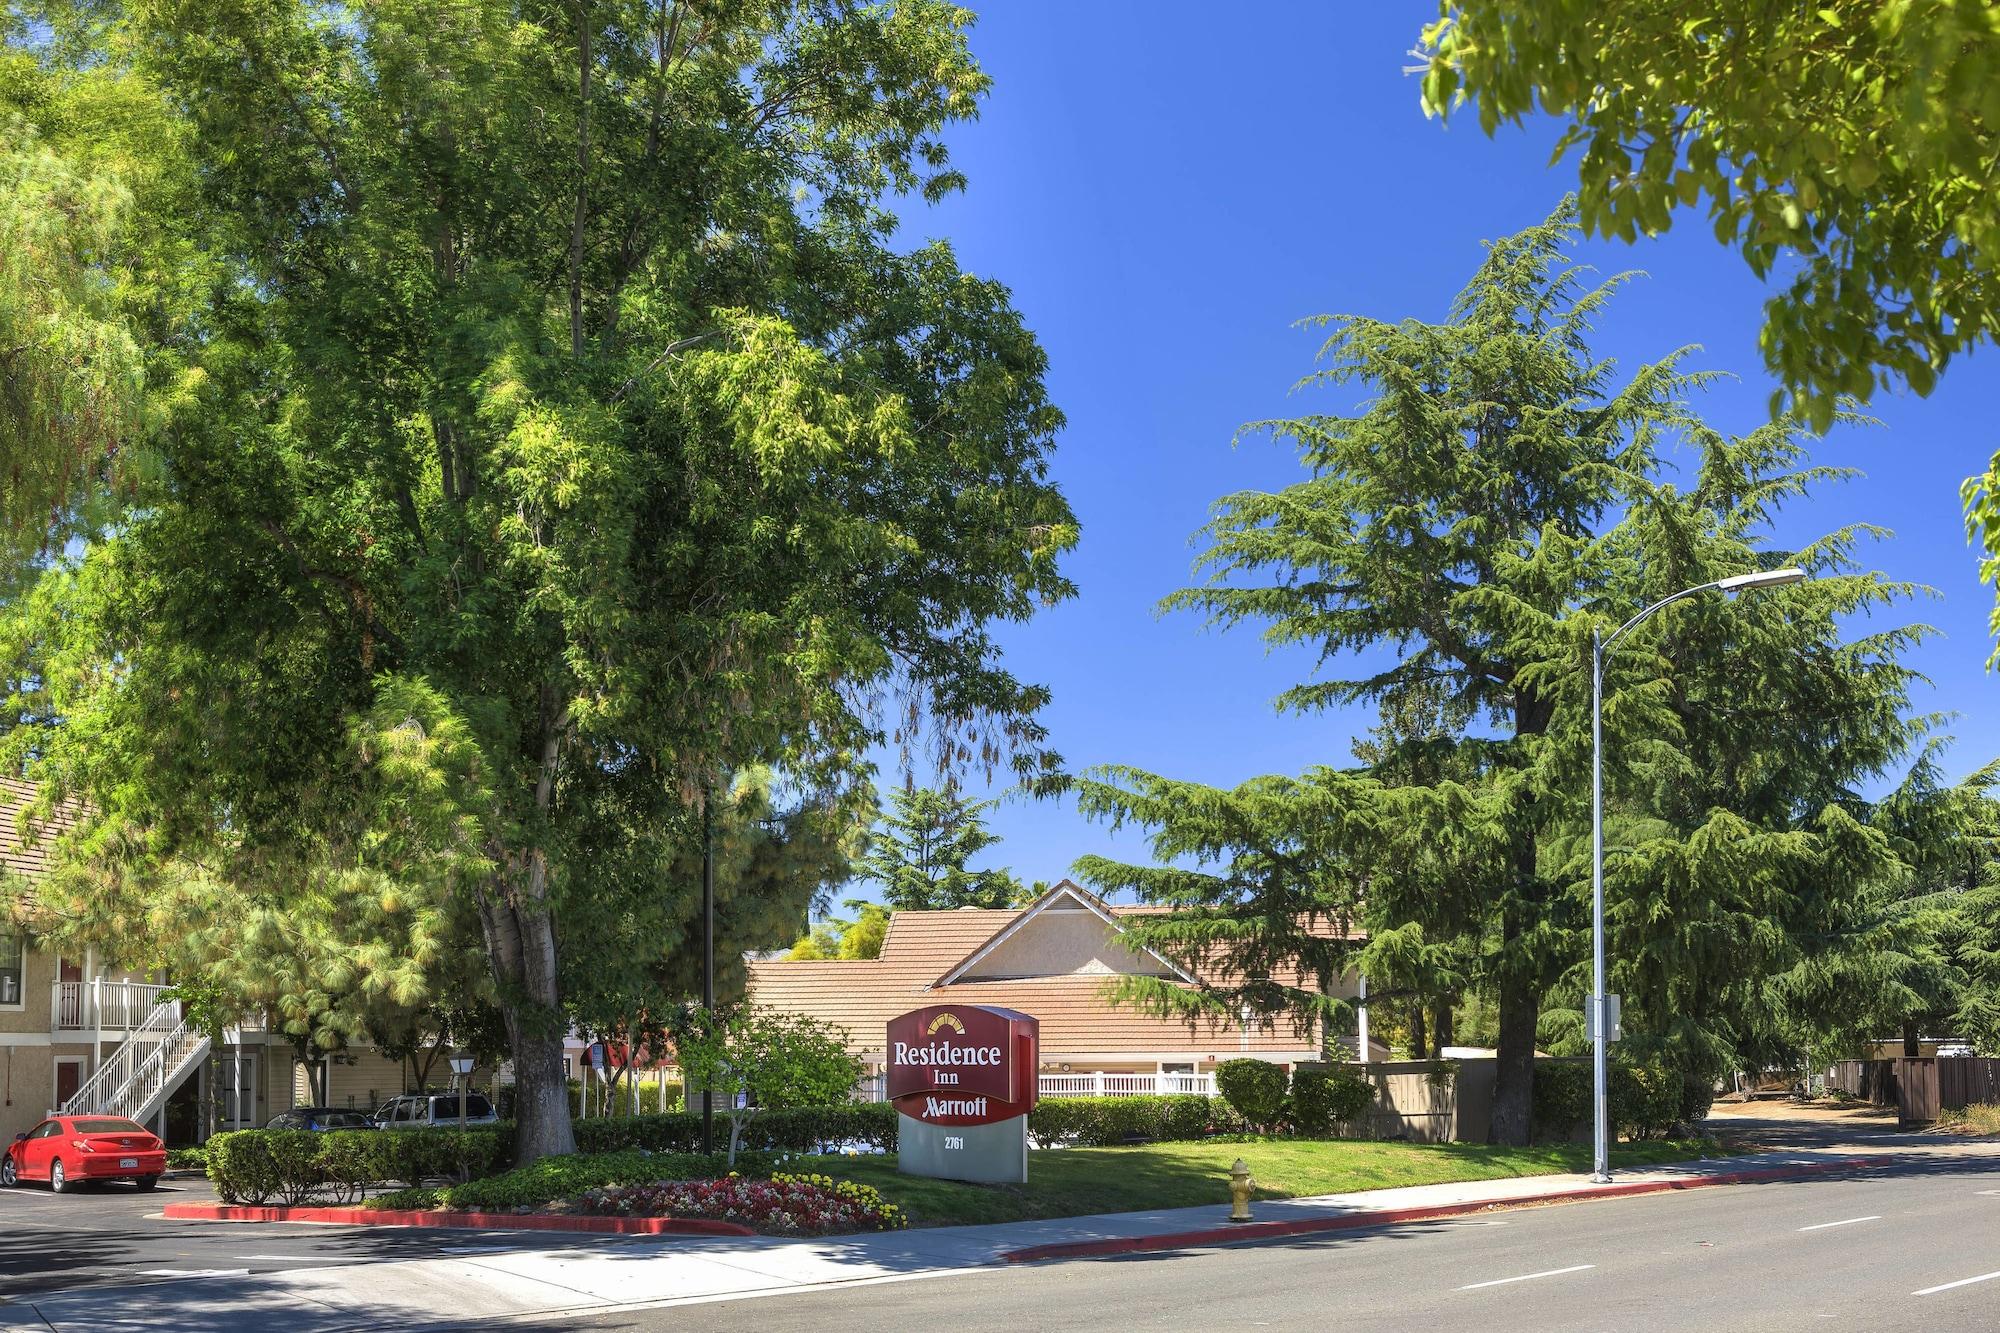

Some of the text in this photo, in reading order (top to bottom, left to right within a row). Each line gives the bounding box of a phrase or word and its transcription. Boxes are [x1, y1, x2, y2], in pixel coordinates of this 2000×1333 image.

[894, 1041, 1001, 1066] Residence
[934, 1070, 959, 1084] Inn
[922, 1096, 987, 1118] Marriott
[945, 1137, 963, 1150] 2761
